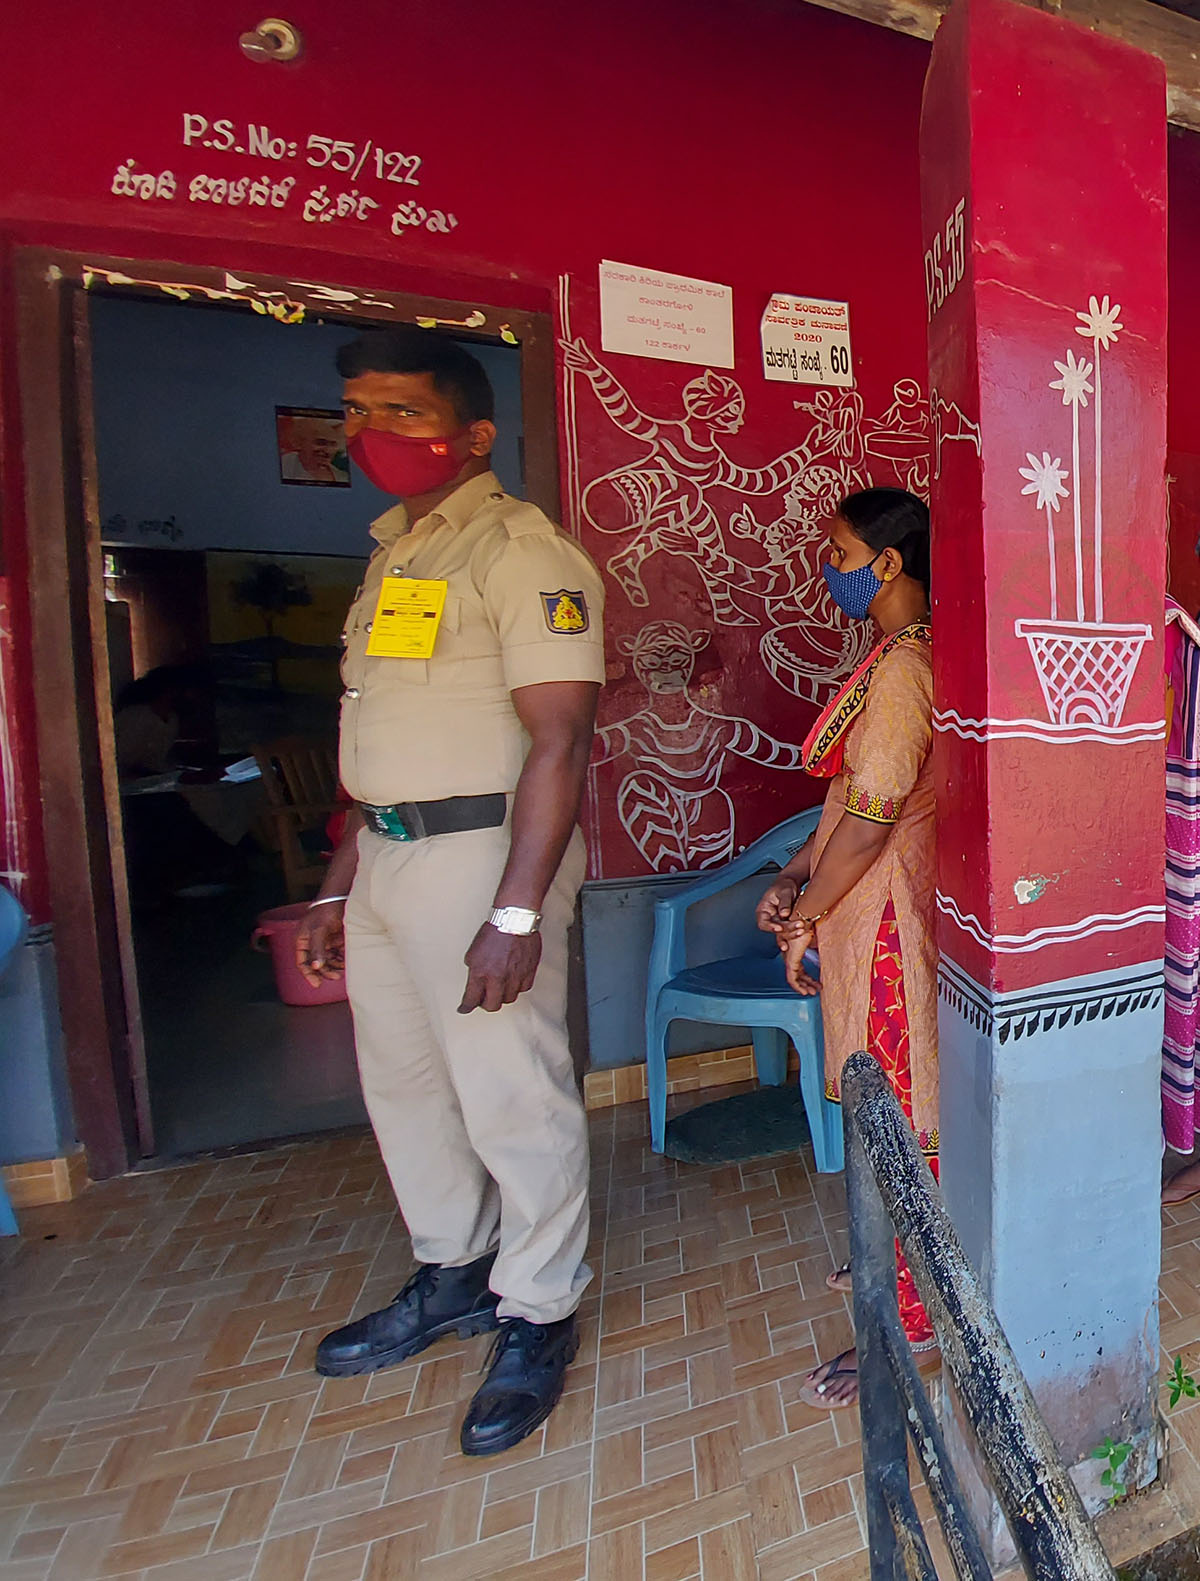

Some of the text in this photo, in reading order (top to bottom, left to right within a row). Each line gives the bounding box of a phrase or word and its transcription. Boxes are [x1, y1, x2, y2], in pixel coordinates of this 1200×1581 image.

[306, 133, 423, 186] 55/122
[695, 326, 706, 334] 60
[644, 338, 660, 348] 122
[793, 332, 823, 343] 2020
[765, 346, 799, 381] ಮತಗಟ್ಟೆ
[830, 345, 849, 375] 60
